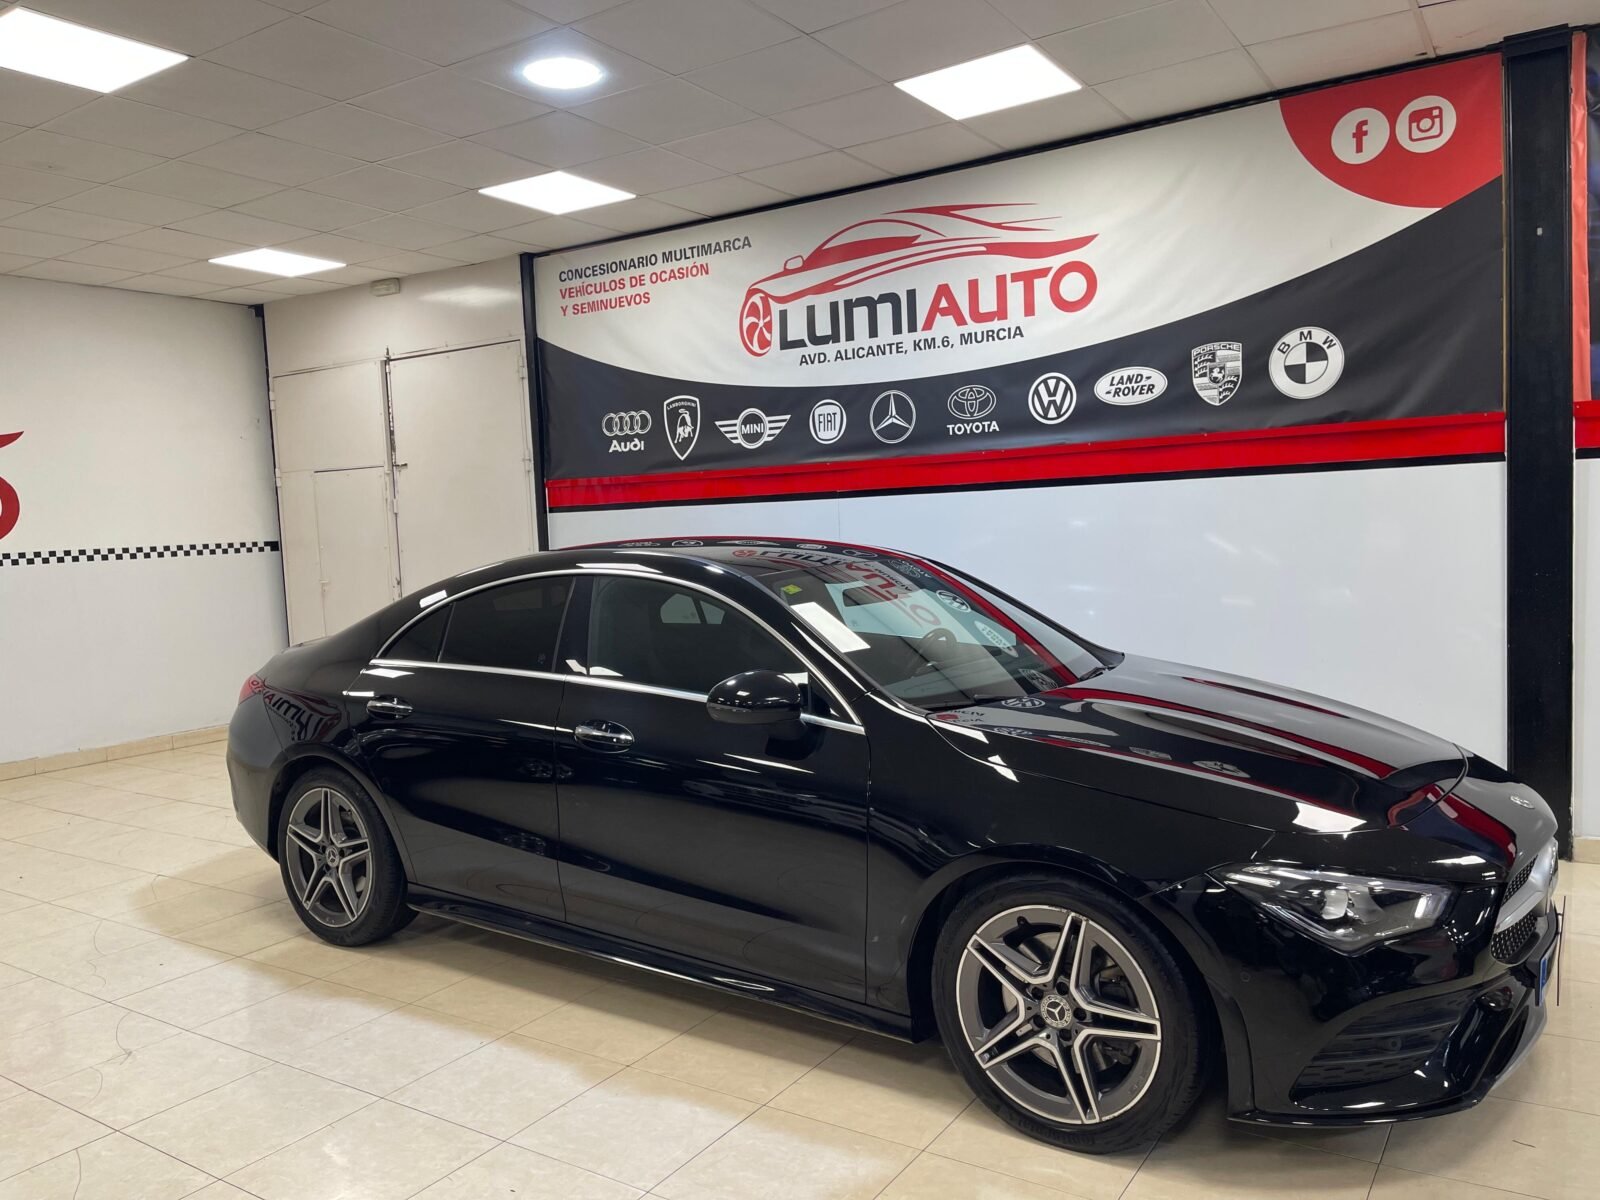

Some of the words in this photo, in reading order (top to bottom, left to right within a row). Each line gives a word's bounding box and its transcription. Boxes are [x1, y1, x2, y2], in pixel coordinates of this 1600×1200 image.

[559, 253, 658, 283] CONCESIONARIO
[661, 236, 752, 265] MULTIMARCA
[560, 277, 626, 300] VEHÍCULOS
[629, 274, 646, 289] DE
[649, 262, 710, 284] OCASIÓN
[560, 305, 569, 317] Y
[572, 291, 651, 316] SEMINUEVOS
[799, 353, 831, 367] AVD.
[834, 341, 908, 363] ALICANTE,
[912, 334, 954, 352] KM.6,
[959, 325, 1024, 346] MURCIA
[741, 422, 764, 435] MINI
[818, 411, 838, 433] FIAT
[946, 420, 1000, 436] TOYOTA
[608, 438, 645, 453] Audi
